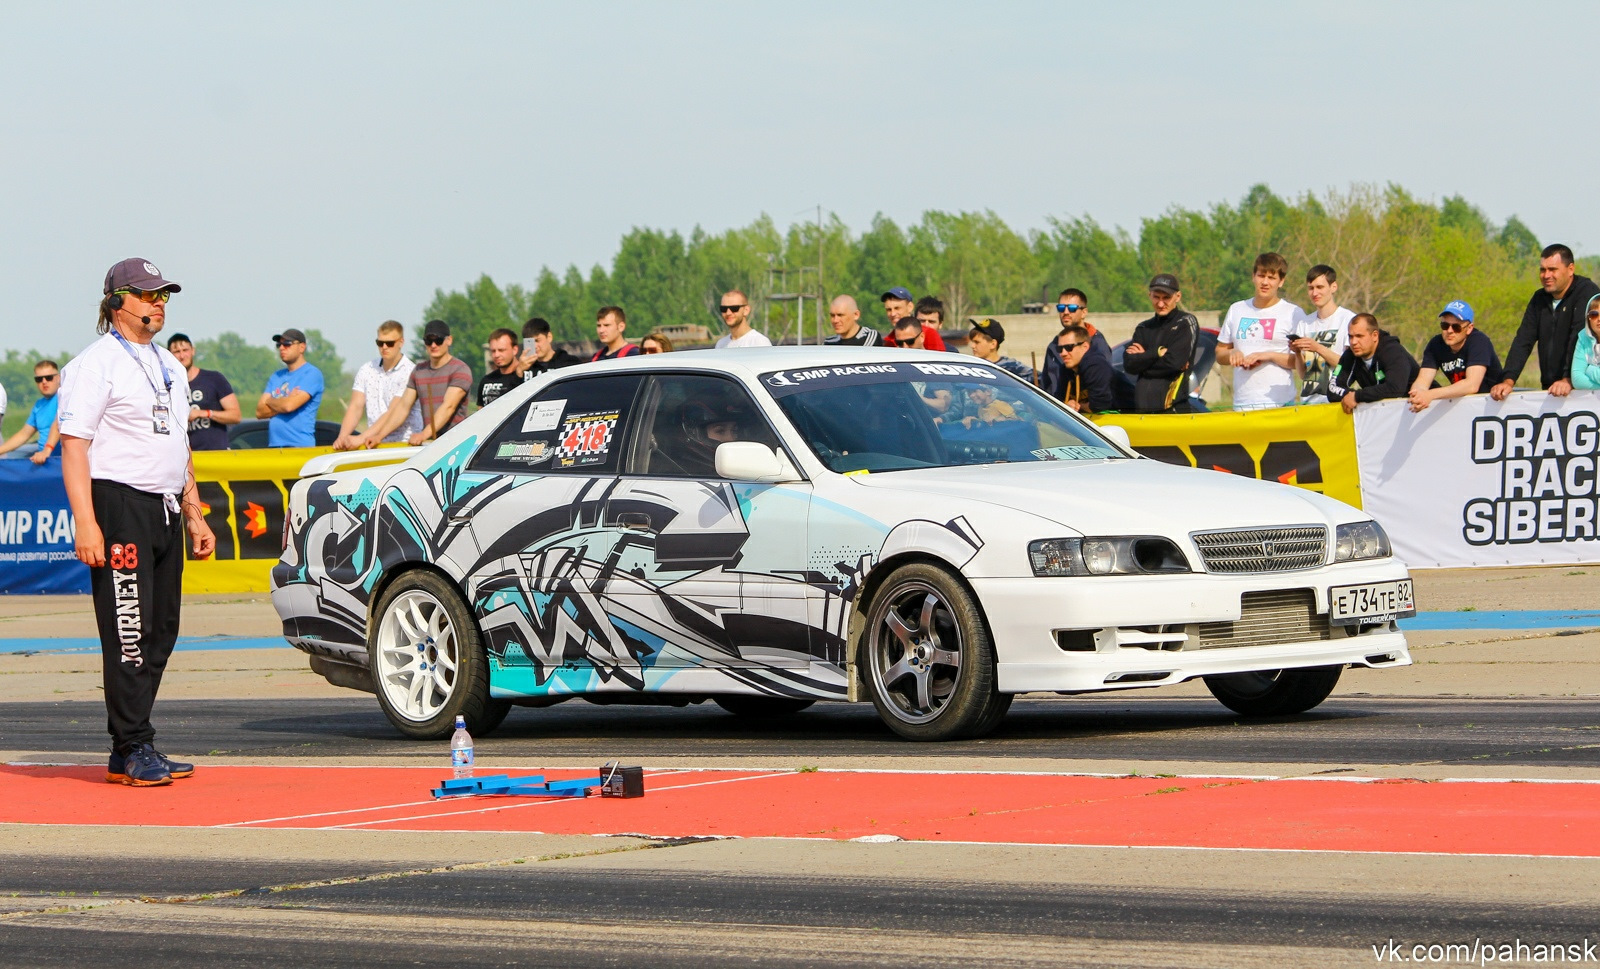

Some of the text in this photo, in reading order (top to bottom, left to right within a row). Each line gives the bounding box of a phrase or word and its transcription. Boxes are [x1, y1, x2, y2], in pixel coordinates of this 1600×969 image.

[793, 365, 897, 382] SMP RACING
[563, 423, 607, 453] 418
[1471, 411, 1600, 464] DRAG
[0, 510, 33, 545] MP
[1397, 583, 1409, 602] 82
[112, 569, 144, 668] JOURNEY
